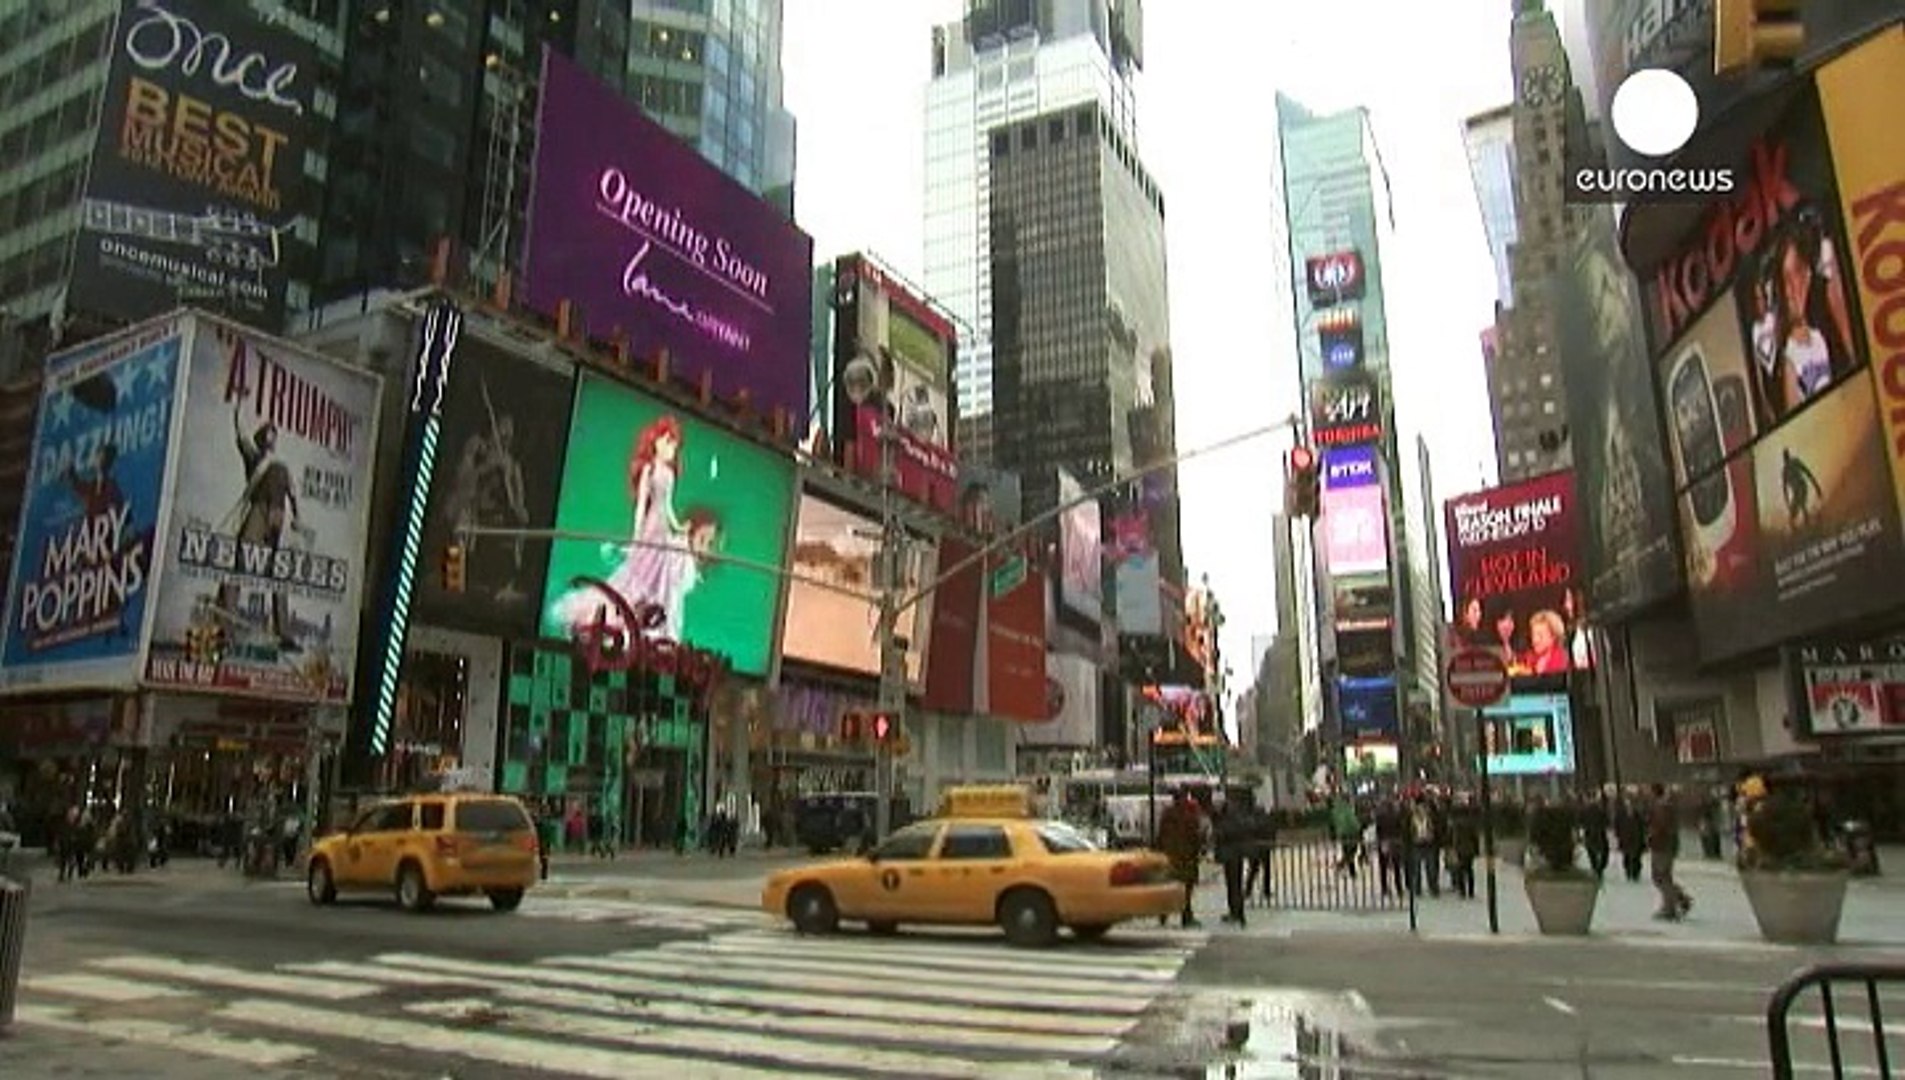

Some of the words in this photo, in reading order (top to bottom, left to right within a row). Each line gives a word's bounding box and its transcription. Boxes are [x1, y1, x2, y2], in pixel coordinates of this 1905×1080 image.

[126, 77, 289, 168] BEST
[600, 168, 709, 266] Opening
[712, 237, 768, 298] Soon
[44, 500, 131, 579] MARY
[177, 527, 348, 592] NEWSIES
[1526, 547, 1546, 571] IN
[20, 541, 144, 632] POPPINS
[1463, 562, 1571, 598] CLEVELAND
